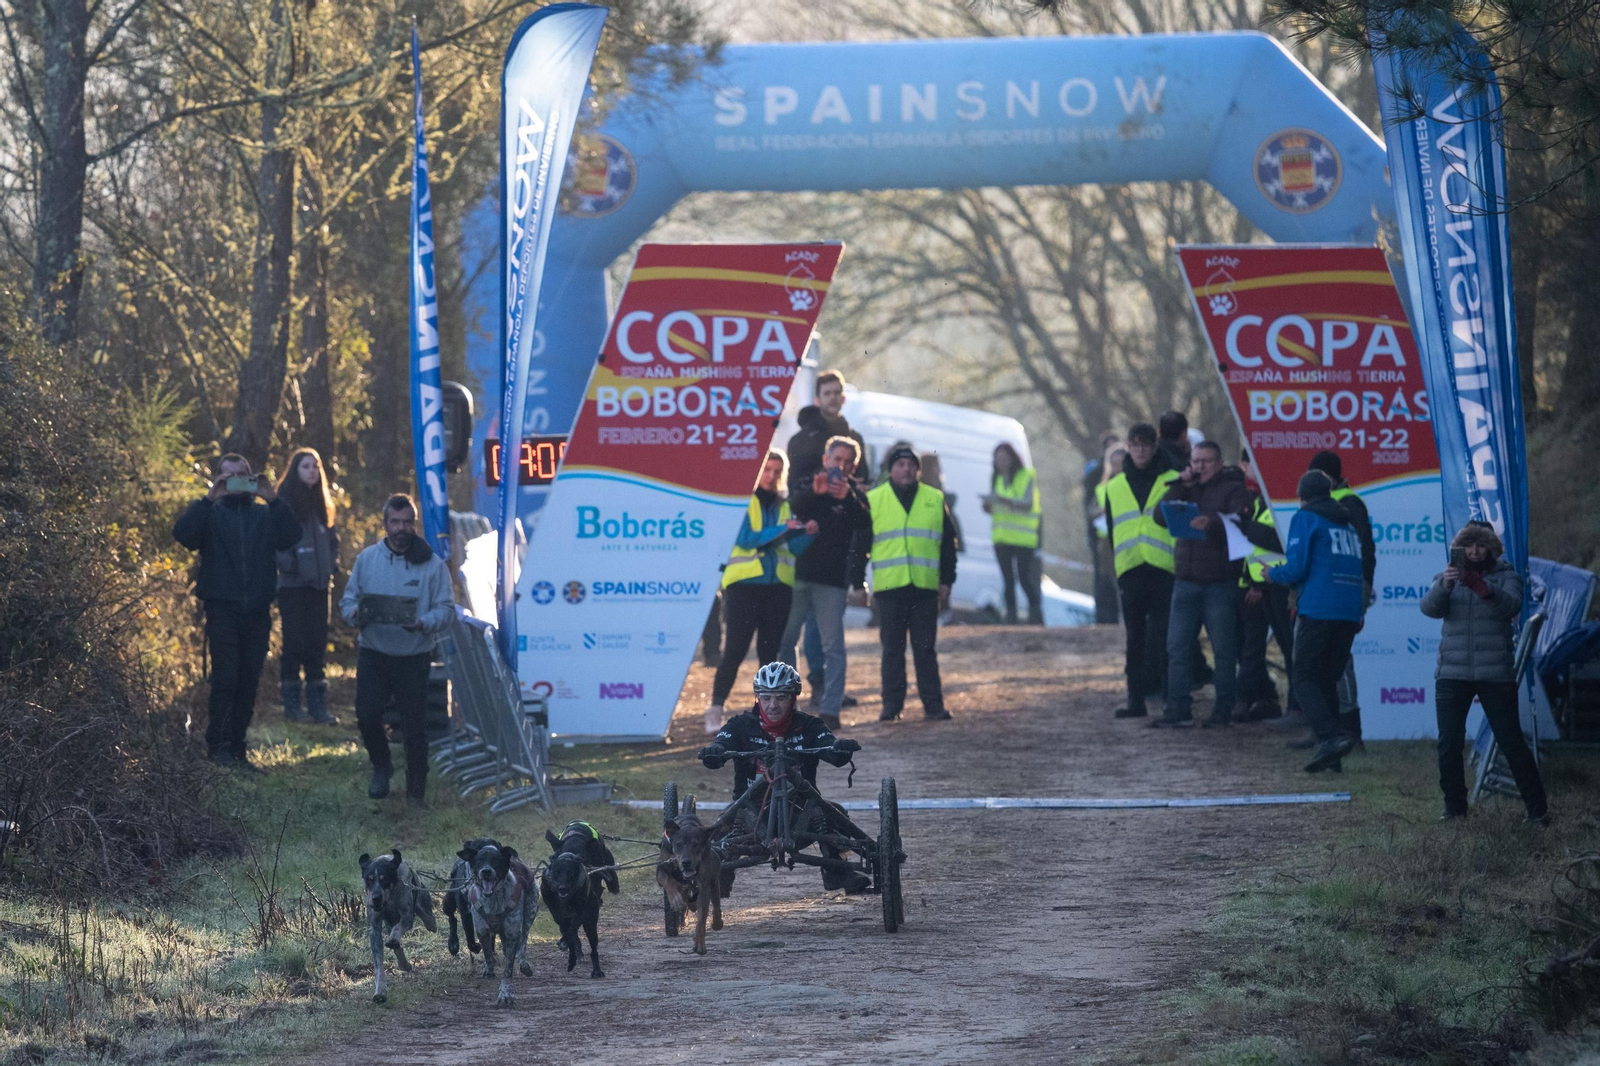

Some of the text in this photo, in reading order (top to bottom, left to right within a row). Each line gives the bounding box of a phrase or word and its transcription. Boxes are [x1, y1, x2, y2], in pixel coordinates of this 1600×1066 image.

[714, 74, 1167, 127] SPAINSNOW
[537, 111, 560, 186] INVIERNO
[785, 251, 820, 264] ACADE
[616, 310, 797, 364] COPA
[1225, 314, 1406, 368] COPA
[620, 364, 796, 379] ESPAÑA MUSHING TIERRA
[1229, 368, 1406, 383] ESPAÑA MUSHING TIERRA
[596, 382, 783, 418] BOBORÁS
[1250, 386, 1432, 422] BOBORÁS
[598, 424, 758, 445] FEBRERO 21-22
[1252, 428, 1409, 449] FEBRERO 21-22
[576, 505, 705, 539] Boborás
[1371, 515, 1445, 543] borás
[592, 581, 702, 595] SPAINSNOW
